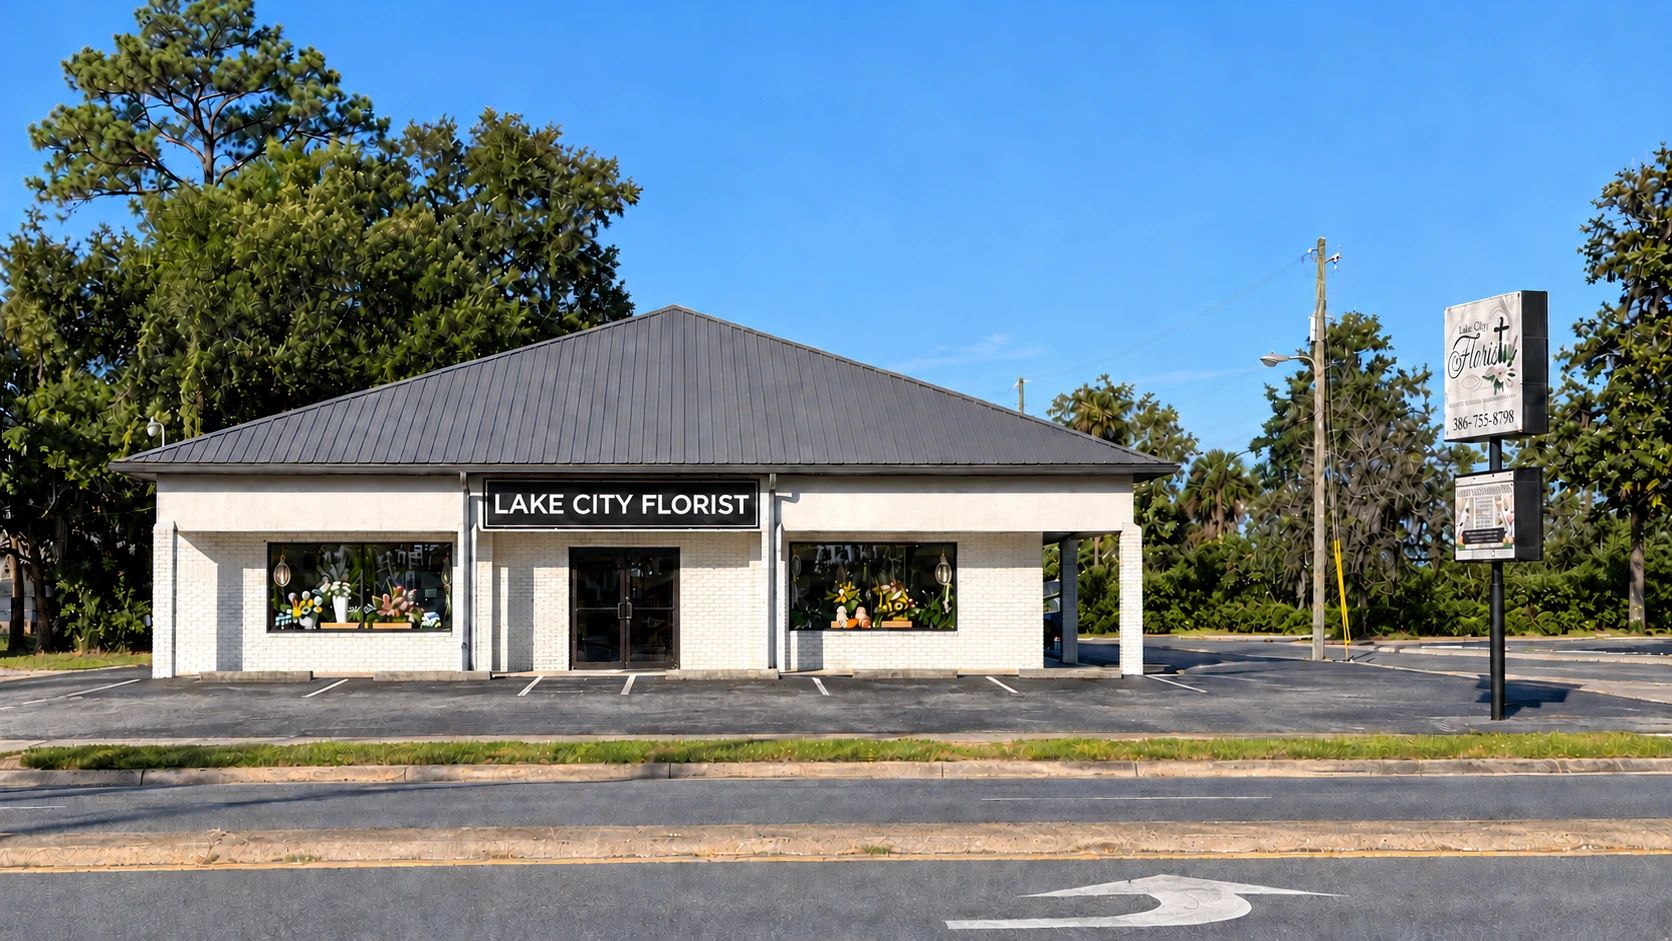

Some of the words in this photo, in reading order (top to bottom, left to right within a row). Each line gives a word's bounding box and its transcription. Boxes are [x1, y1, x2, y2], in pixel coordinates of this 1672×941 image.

[1458, 324, 1472, 335] Lake
[1473, 320, 1489, 333] City
[1448, 317, 1509, 379] Florist
[1453, 409, 1515, 431] 386-755-8798
[494, 493, 564, 515] LAKE
[572, 493, 633, 515] CITY
[641, 493, 750, 515] FLORIST
